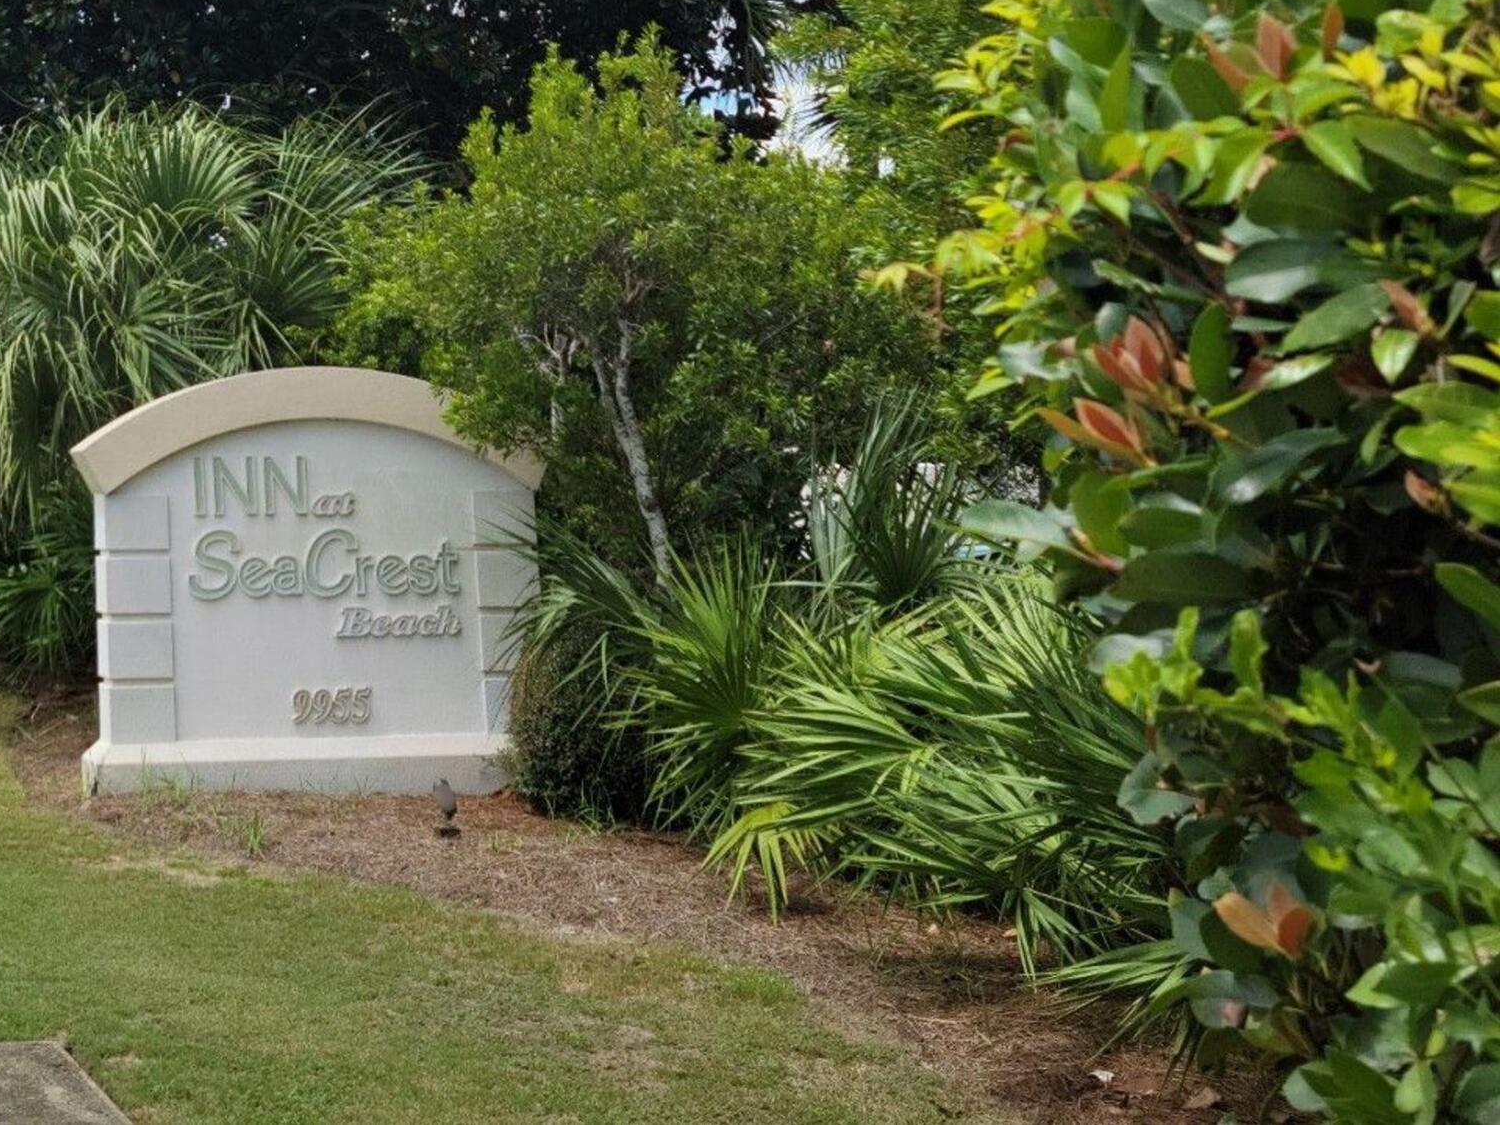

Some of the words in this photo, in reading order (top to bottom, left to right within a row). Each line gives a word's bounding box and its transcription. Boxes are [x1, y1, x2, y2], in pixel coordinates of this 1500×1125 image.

[193, 455, 309, 518] INN
[311, 490, 357, 518] at
[188, 528, 461, 602] SeaCrest
[335, 604, 462, 639] Beach
[292, 686, 373, 725] 9955
